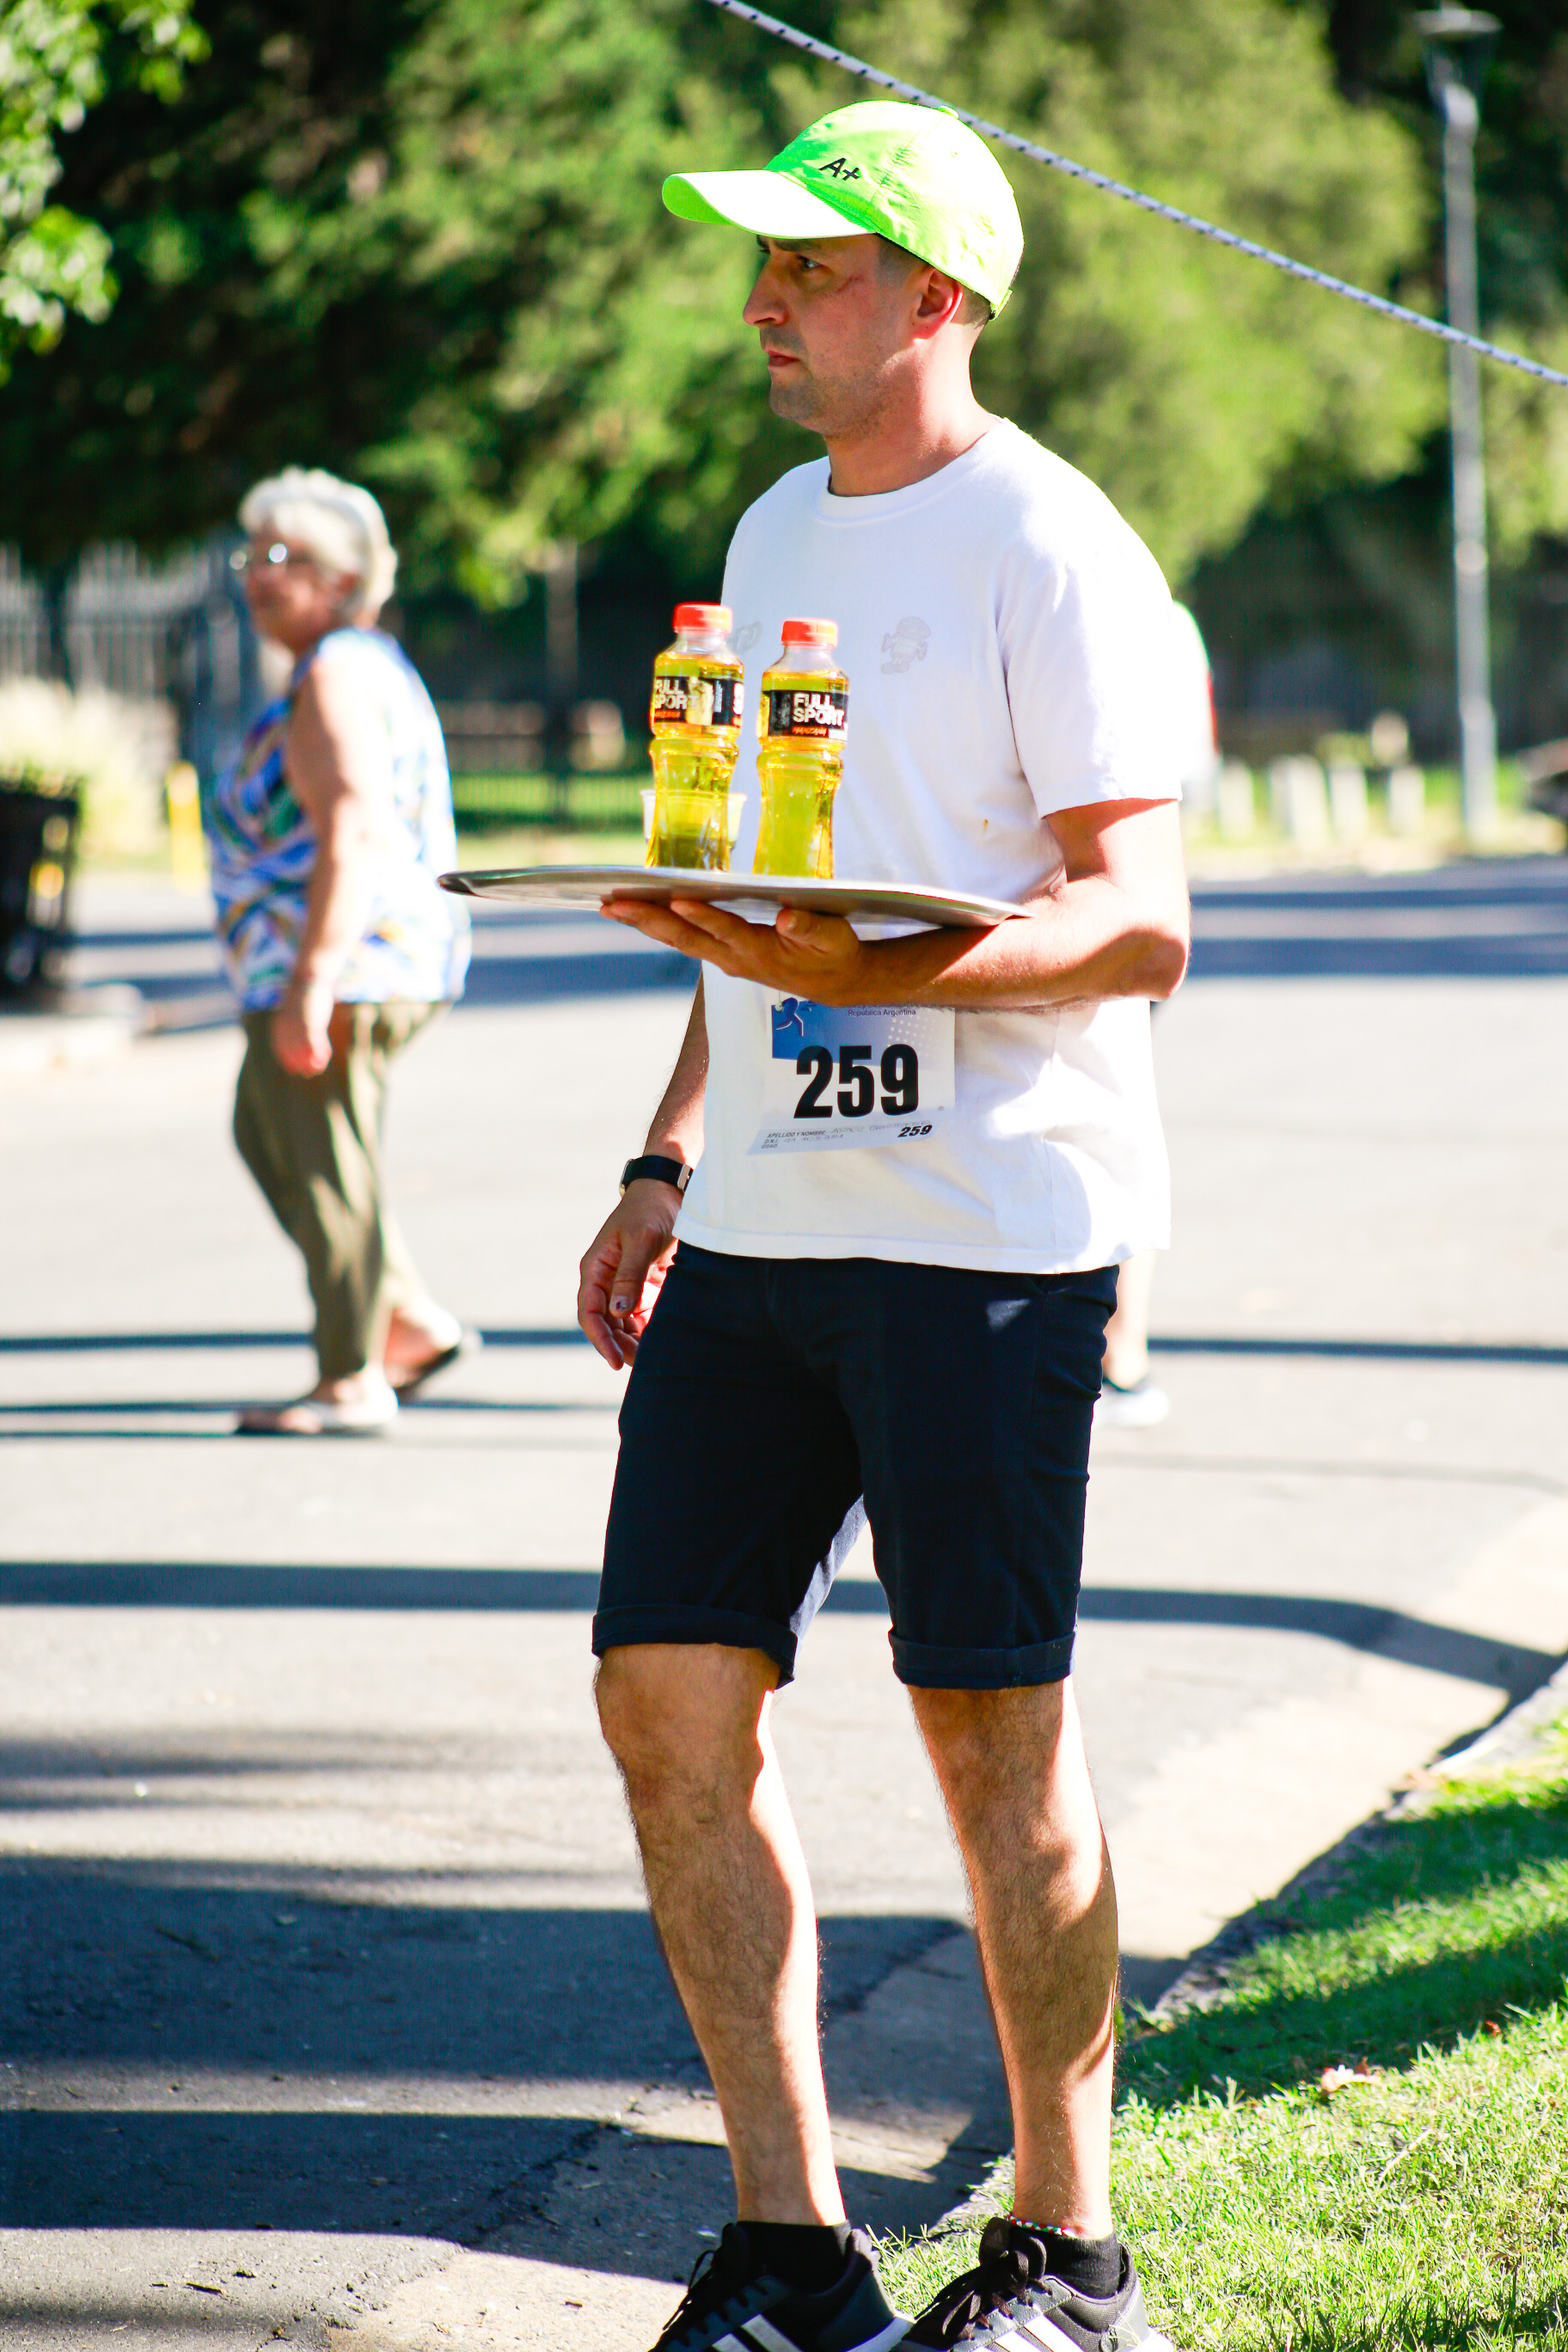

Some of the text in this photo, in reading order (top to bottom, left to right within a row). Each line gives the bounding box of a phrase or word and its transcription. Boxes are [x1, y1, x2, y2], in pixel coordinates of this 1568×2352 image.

[818, 157, 859, 181] A+
[793, 693, 835, 711] FULL
[793, 707, 845, 727] SPORT
[793, 1044, 918, 1119] 259
[897, 1124, 933, 1138] 259
